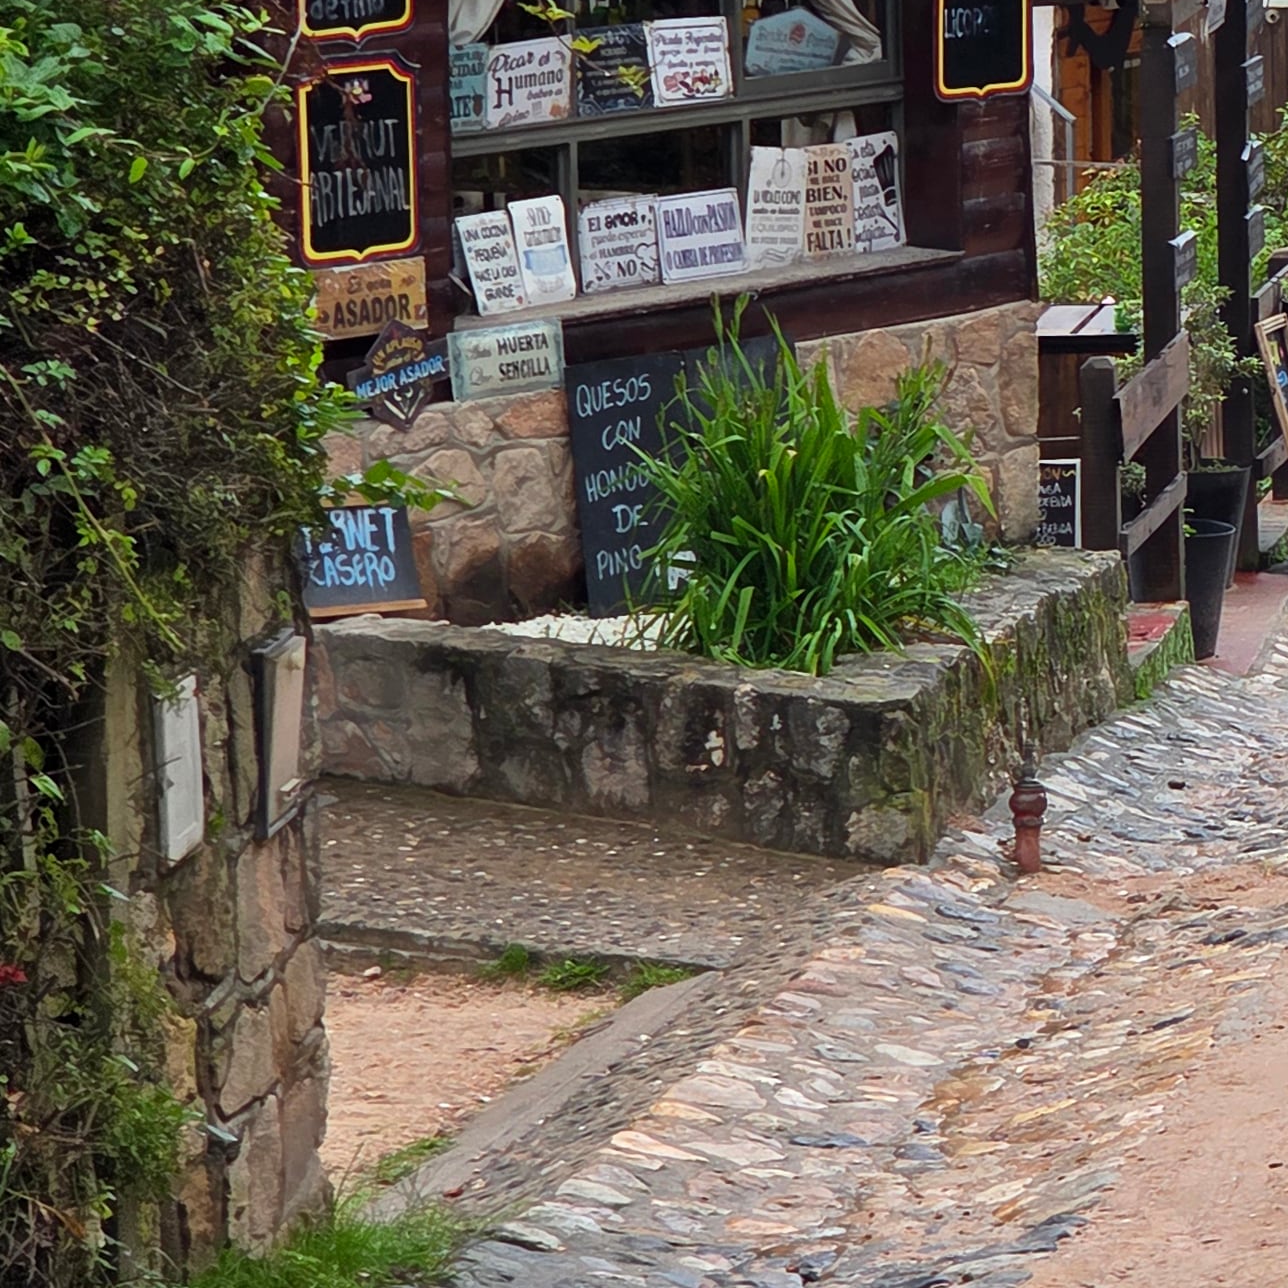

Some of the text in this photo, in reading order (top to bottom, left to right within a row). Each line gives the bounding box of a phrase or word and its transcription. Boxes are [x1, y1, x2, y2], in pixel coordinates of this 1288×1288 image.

[493, 68, 563, 109] Humano
[824, 158, 847, 174] NO
[310, 166, 411, 228] ARTESANAL
[806, 185, 849, 203] BIEN,
[617, 259, 638, 278] NO
[333, 293, 412, 330] ASADOR
[497, 333, 549, 356] MUERTA
[355, 354, 446, 399] MEJOR ASADOR
[499, 359, 551, 382] SENCILLA
[575, 373, 651, 418] QUESOS
[602, 416, 641, 451] CON
[309, 552, 396, 589] CASERO
[596, 543, 644, 580] PINO
